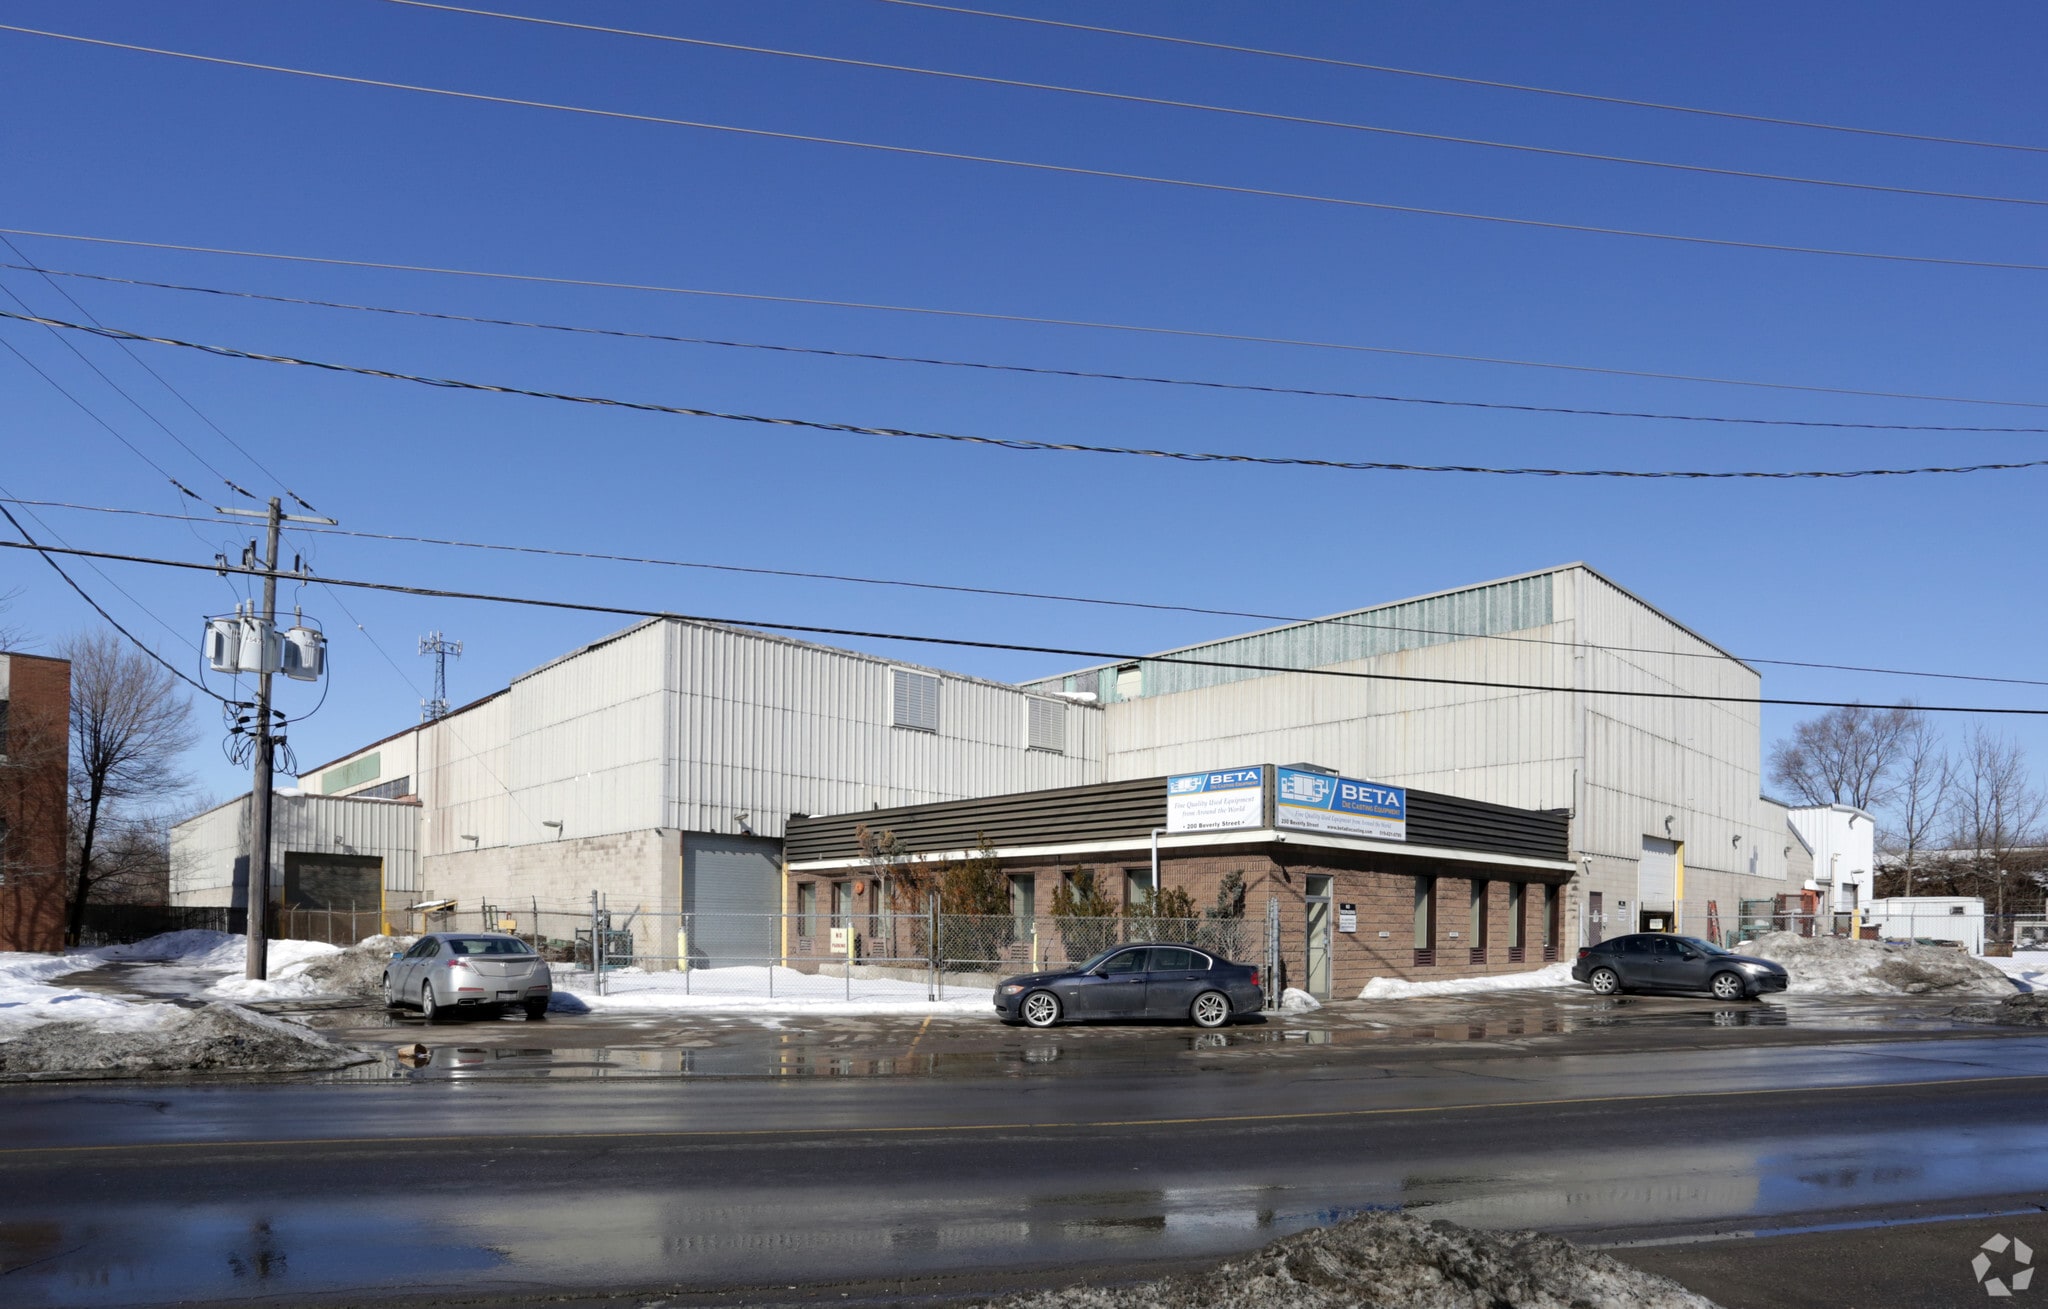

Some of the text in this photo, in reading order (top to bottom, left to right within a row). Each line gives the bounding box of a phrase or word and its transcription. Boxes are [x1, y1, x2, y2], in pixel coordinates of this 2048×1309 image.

[1210, 771, 1258, 784] BETA
[1341, 784, 1400, 807] BETA
[1186, 799, 1208, 809] Quality
[1208, 798, 1222, 806] Used
[1223, 796, 1255, 805] Equipment
[1196, 808, 1217, 816] Around
[1228, 805, 1246, 813] World
[1198, 820, 1220, 828] Beverly
